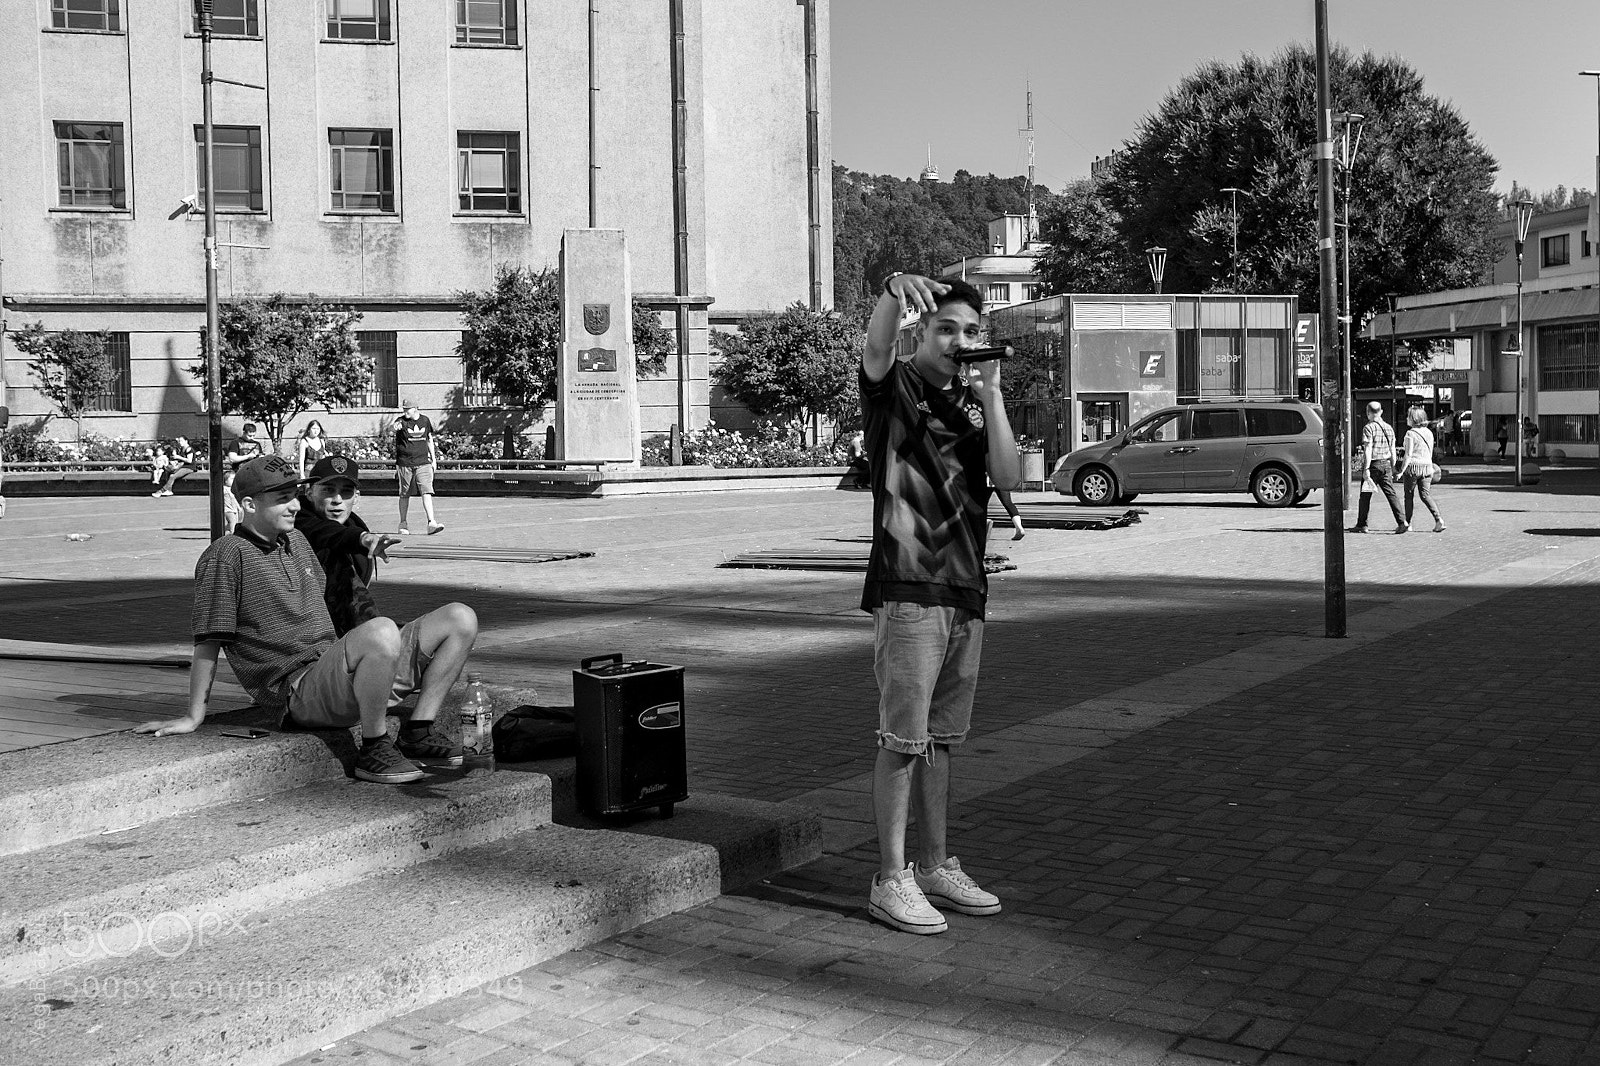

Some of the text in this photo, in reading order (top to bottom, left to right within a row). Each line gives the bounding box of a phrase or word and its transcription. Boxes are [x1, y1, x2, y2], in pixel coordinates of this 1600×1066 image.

[1215, 353, 1240, 363] saba
[1142, 354, 1162, 375] E
[1142, 383, 1161, 391] saba
